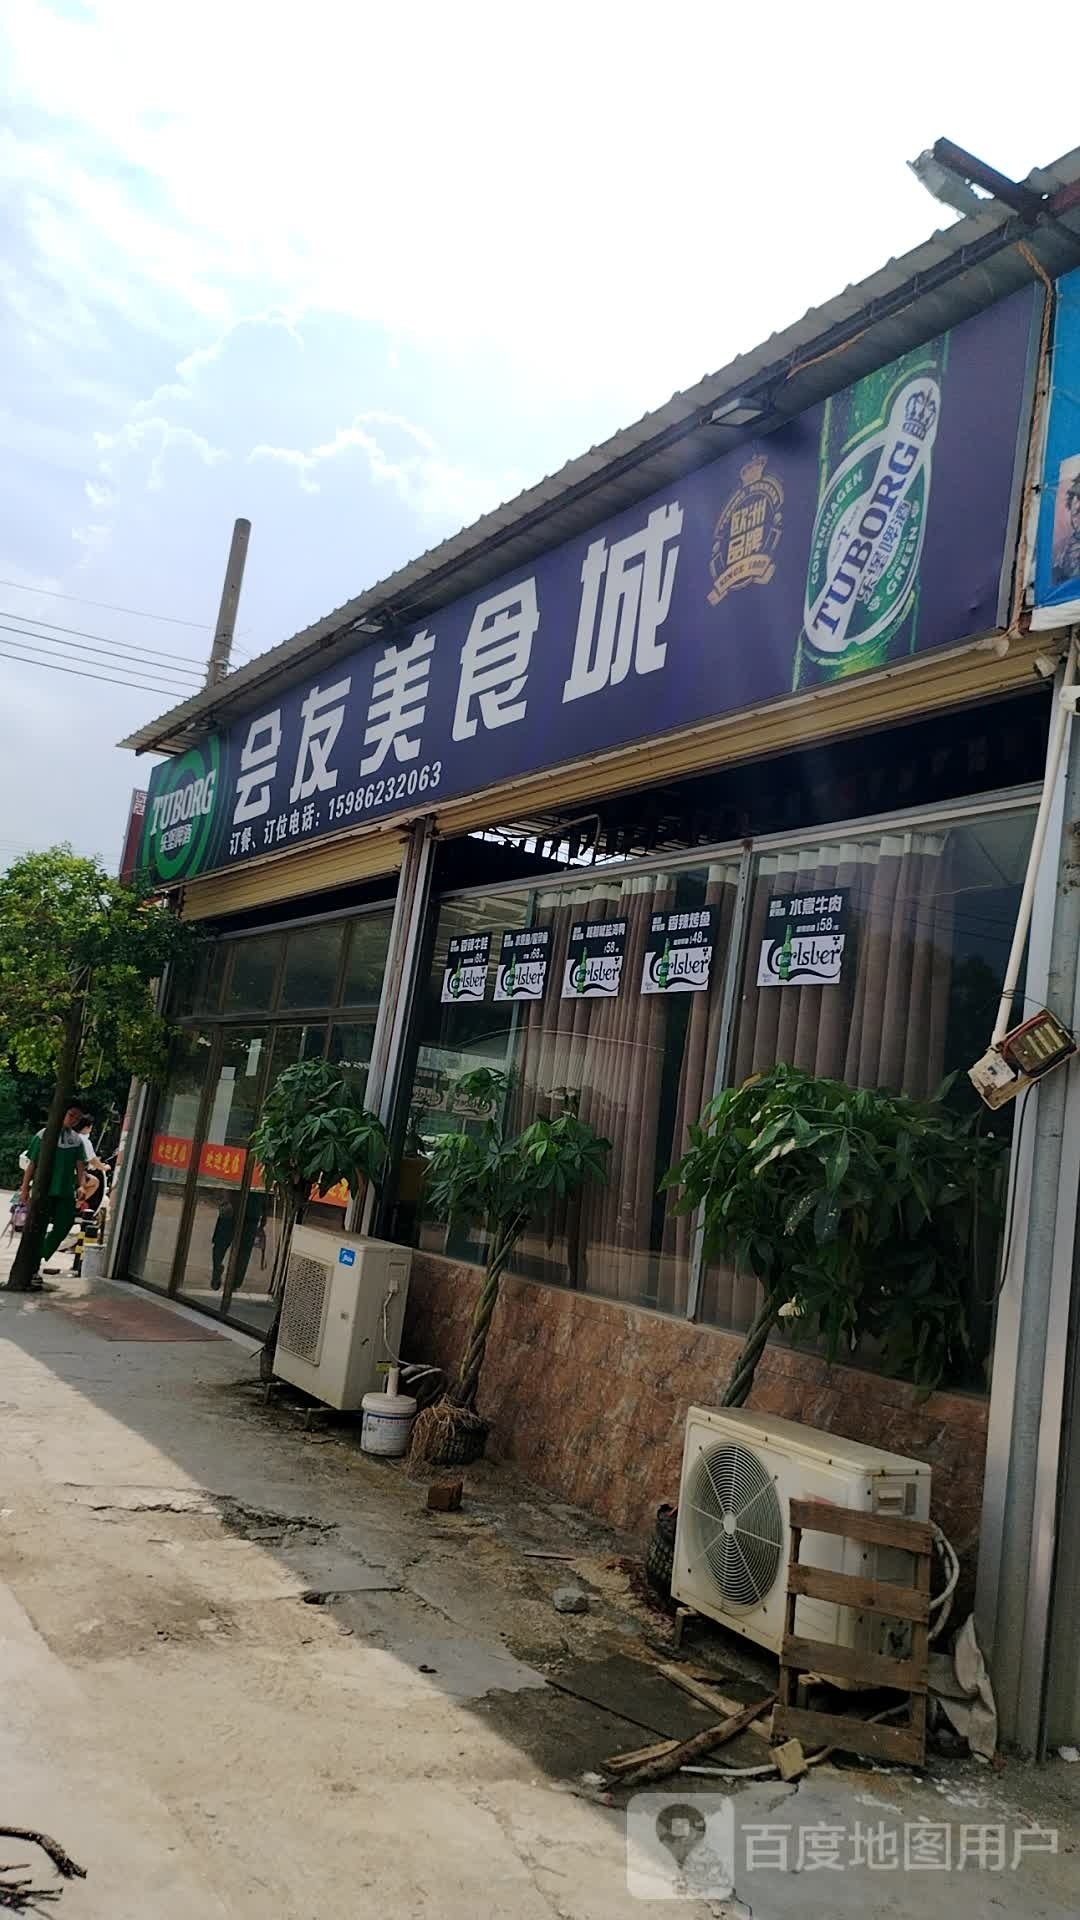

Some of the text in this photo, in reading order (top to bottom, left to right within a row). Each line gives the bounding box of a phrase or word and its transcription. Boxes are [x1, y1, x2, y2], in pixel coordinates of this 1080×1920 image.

[811, 468, 864, 586] COPENHAGEN
[811, 440, 919, 635] TUBORG
[886, 526, 919, 593] GREEN
[233, 501, 684, 825] 会友美食城
[150, 769, 217, 837] TUBORG
[328, 761, 442, 820] 15986232063
[789, 895, 843, 916] 水煮牛肉
